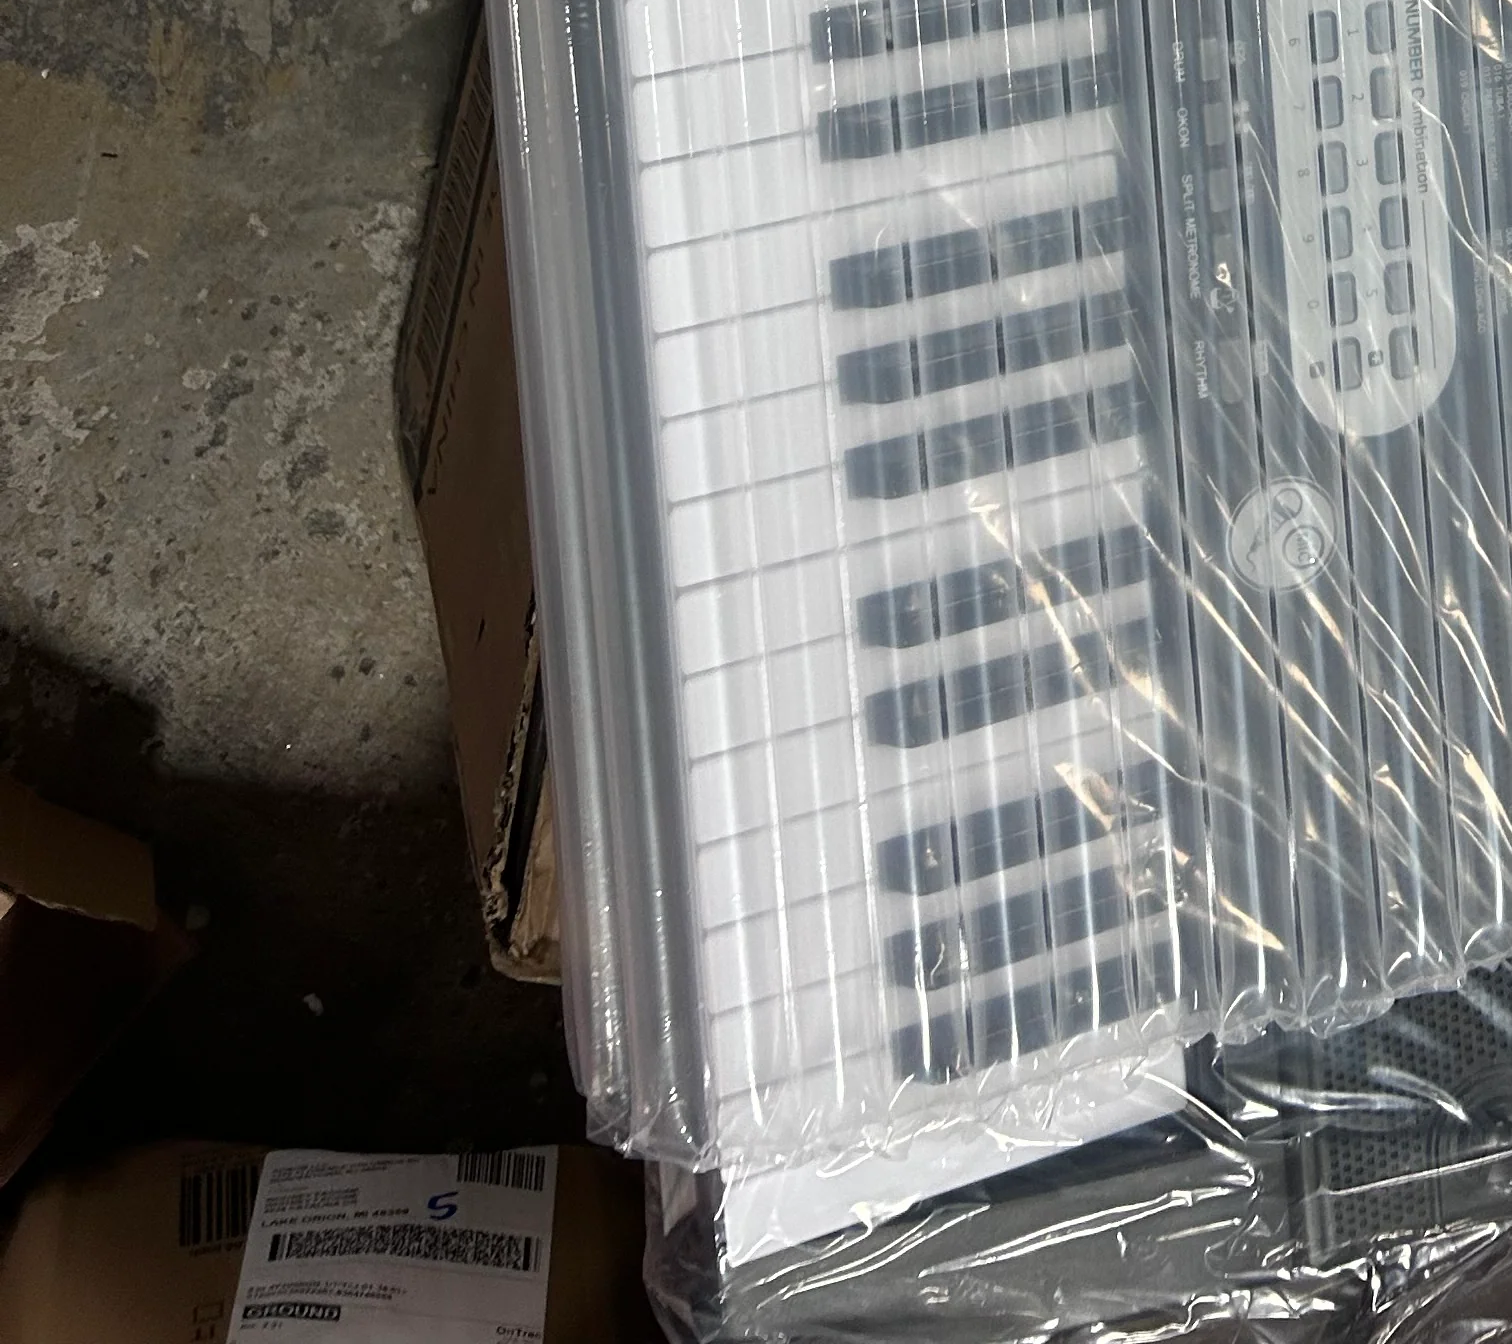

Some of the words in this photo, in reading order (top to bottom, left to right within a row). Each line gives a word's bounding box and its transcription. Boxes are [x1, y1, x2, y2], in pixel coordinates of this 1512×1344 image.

[1346, 27, 1358, 37] 1
[1287, 37, 1300, 47] 6
[1404, 0, 1423, 82] NUMBER
[1170, 41, 1185, 84] DRUM
[1351, 93, 1363, 102] 2
[1175, 107, 1190, 148] OKON
[1355, 158, 1367, 168] 3
[1296, 169, 1309, 178] 8
[1180, 174, 1195, 212] SPLIT
[1301, 234, 1313, 243] 9
[1183, 216, 1202, 300] METRONOME
[1363, 290, 1376, 299] 5
[1192, 339, 1209, 400] RHYTHM
[1295, 531, 1311, 562] MIC
[244, 1303, 341, 1320] GROUND
